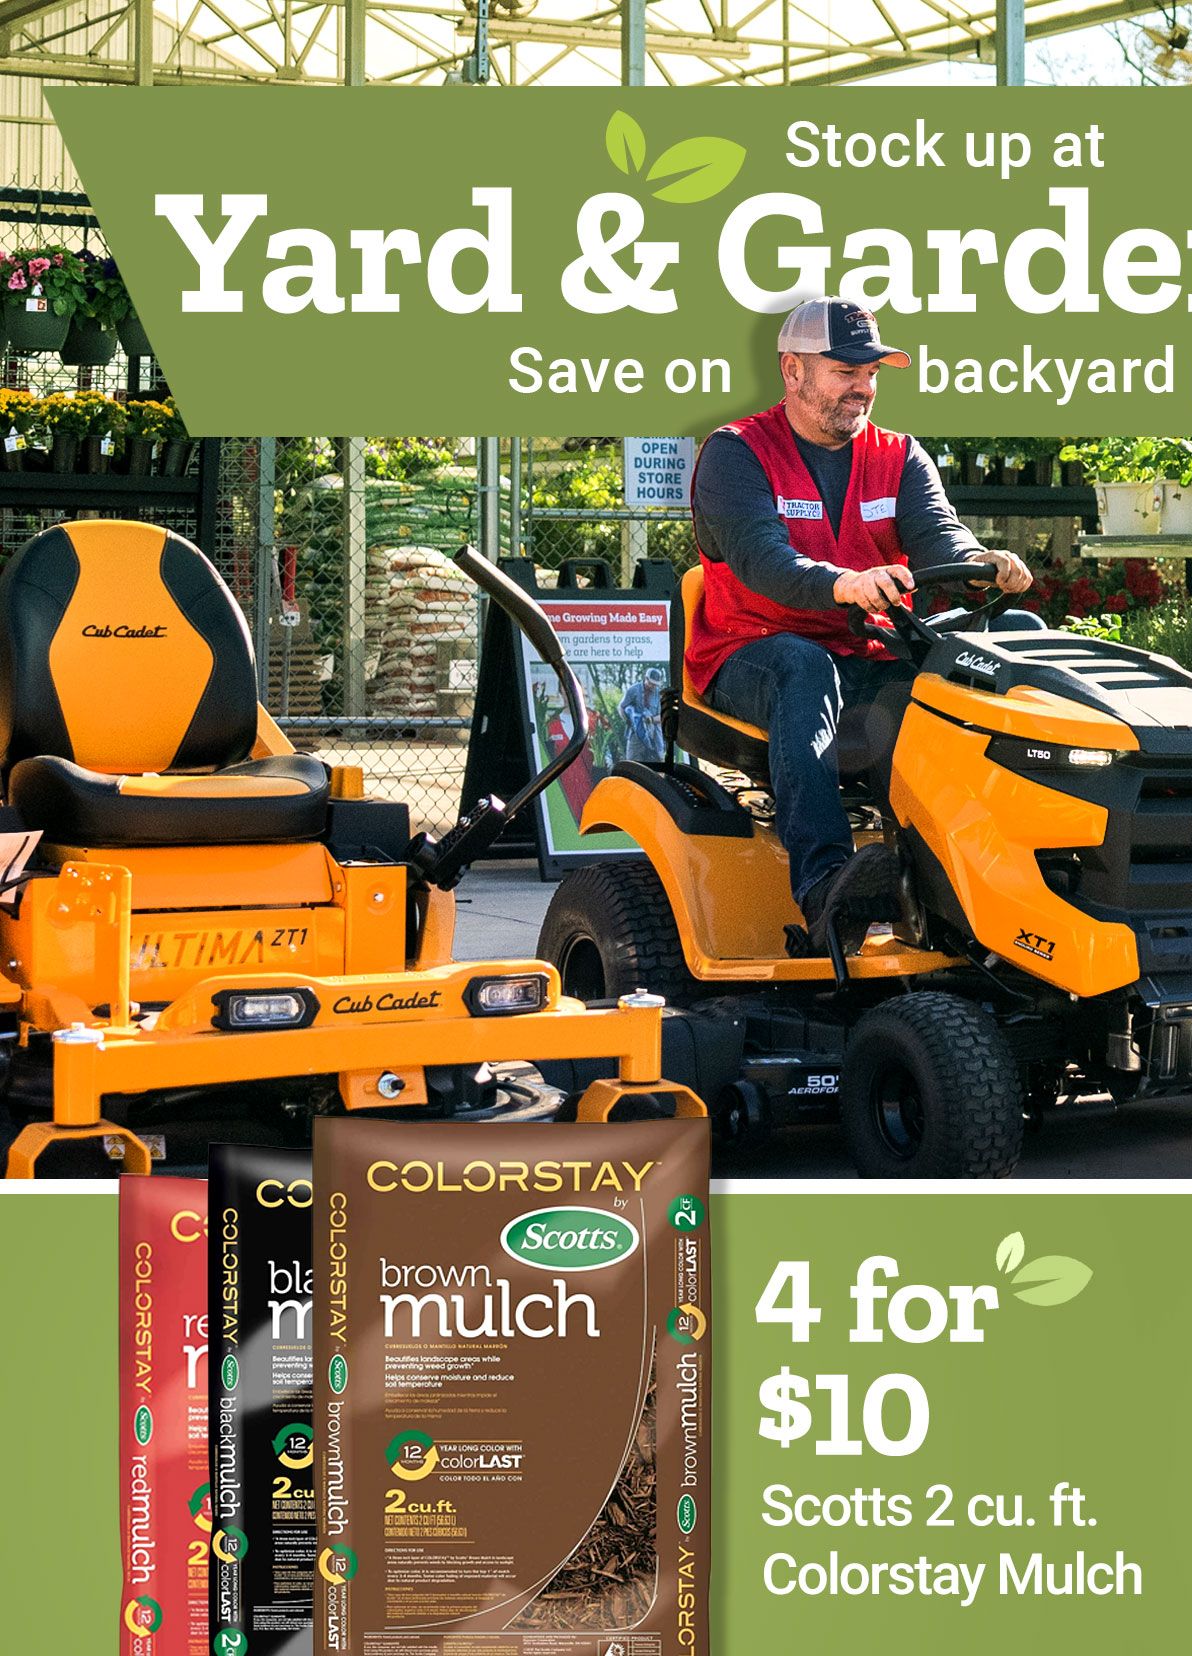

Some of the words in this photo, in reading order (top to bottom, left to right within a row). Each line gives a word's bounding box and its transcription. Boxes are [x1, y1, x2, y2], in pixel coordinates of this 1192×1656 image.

[641, 442, 678, 455] OPEN
[634, 457, 686, 470] DURING
[638, 472, 682, 484] STORE
[637, 487, 684, 499] HOURS
[786, 501, 820, 510] TRACTOR
[786, 509, 812, 517] SUPPLY
[562, 612, 607, 625] Growing
[609, 612, 637, 623] Made
[639, 612, 663, 625] Easy
[82, 624, 112, 638] Cub
[113, 625, 167, 638] Cadet
[573, 634, 611, 646] gardens
[613, 635, 623, 644] to
[624, 636, 653, 647] grass,
[590, 646, 610, 657] here
[612, 648, 622, 657] to
[624, 646, 643, 658] help
[955, 651, 975, 667] Cub
[970, 656, 1001, 676] Cadet
[1027, 748, 1051, 760] LT50
[270, 927, 318, 946] ZT1
[1016, 928, 1056, 953] XT1
[333, 995, 373, 1014] Cub
[375, 990, 442, 1011] Cadet
[367, 1160, 654, 1193] COLORSTAY
[613, 1196, 628, 1210] by
[675, 1210, 696, 1226] 2
[521, 1222, 618, 1250] Scotts
[329, 1192, 348, 1343] COLORSTAY
[380, 1258, 492, 1288] brown
[685, 1238, 697, 1302] colorLAST
[222, 1208, 239, 1345] COLORSTAY
[268, 1261, 313, 1294] bla
[135, 1242, 152, 1393] COLORSTAY
[380, 1279, 600, 1339] mulch
[183, 1314, 208, 1338] re
[385, 1355, 419, 1363] Beautifies
[420, 1355, 459, 1364] landscape
[482, 1355, 501, 1363] while
[385, 1363, 424, 1371] preventing
[385, 1374, 405, 1382] Helps
[398, 1381, 443, 1389] temperature
[676, 1352, 698, 1487] brownmulch
[289, 1437, 306, 1449] 12
[219, 1397, 240, 1518] blackmulch
[404, 1446, 422, 1459] 12
[328, 1401, 349, 1536] brownmulch
[441, 1455, 523, 1469] colorLAST
[491, 1474, 507, 1482] AÑO
[272, 1477, 292, 1499] 2
[384, 1489, 407, 1514] 2
[407, 1500, 457, 1513] cu.ft.
[131, 1455, 156, 1584] redmulch
[336, 1557, 346, 1572] 12
[221, 1564, 231, 1622] colorLAST
[328, 1586, 339, 1650] colorLAST
